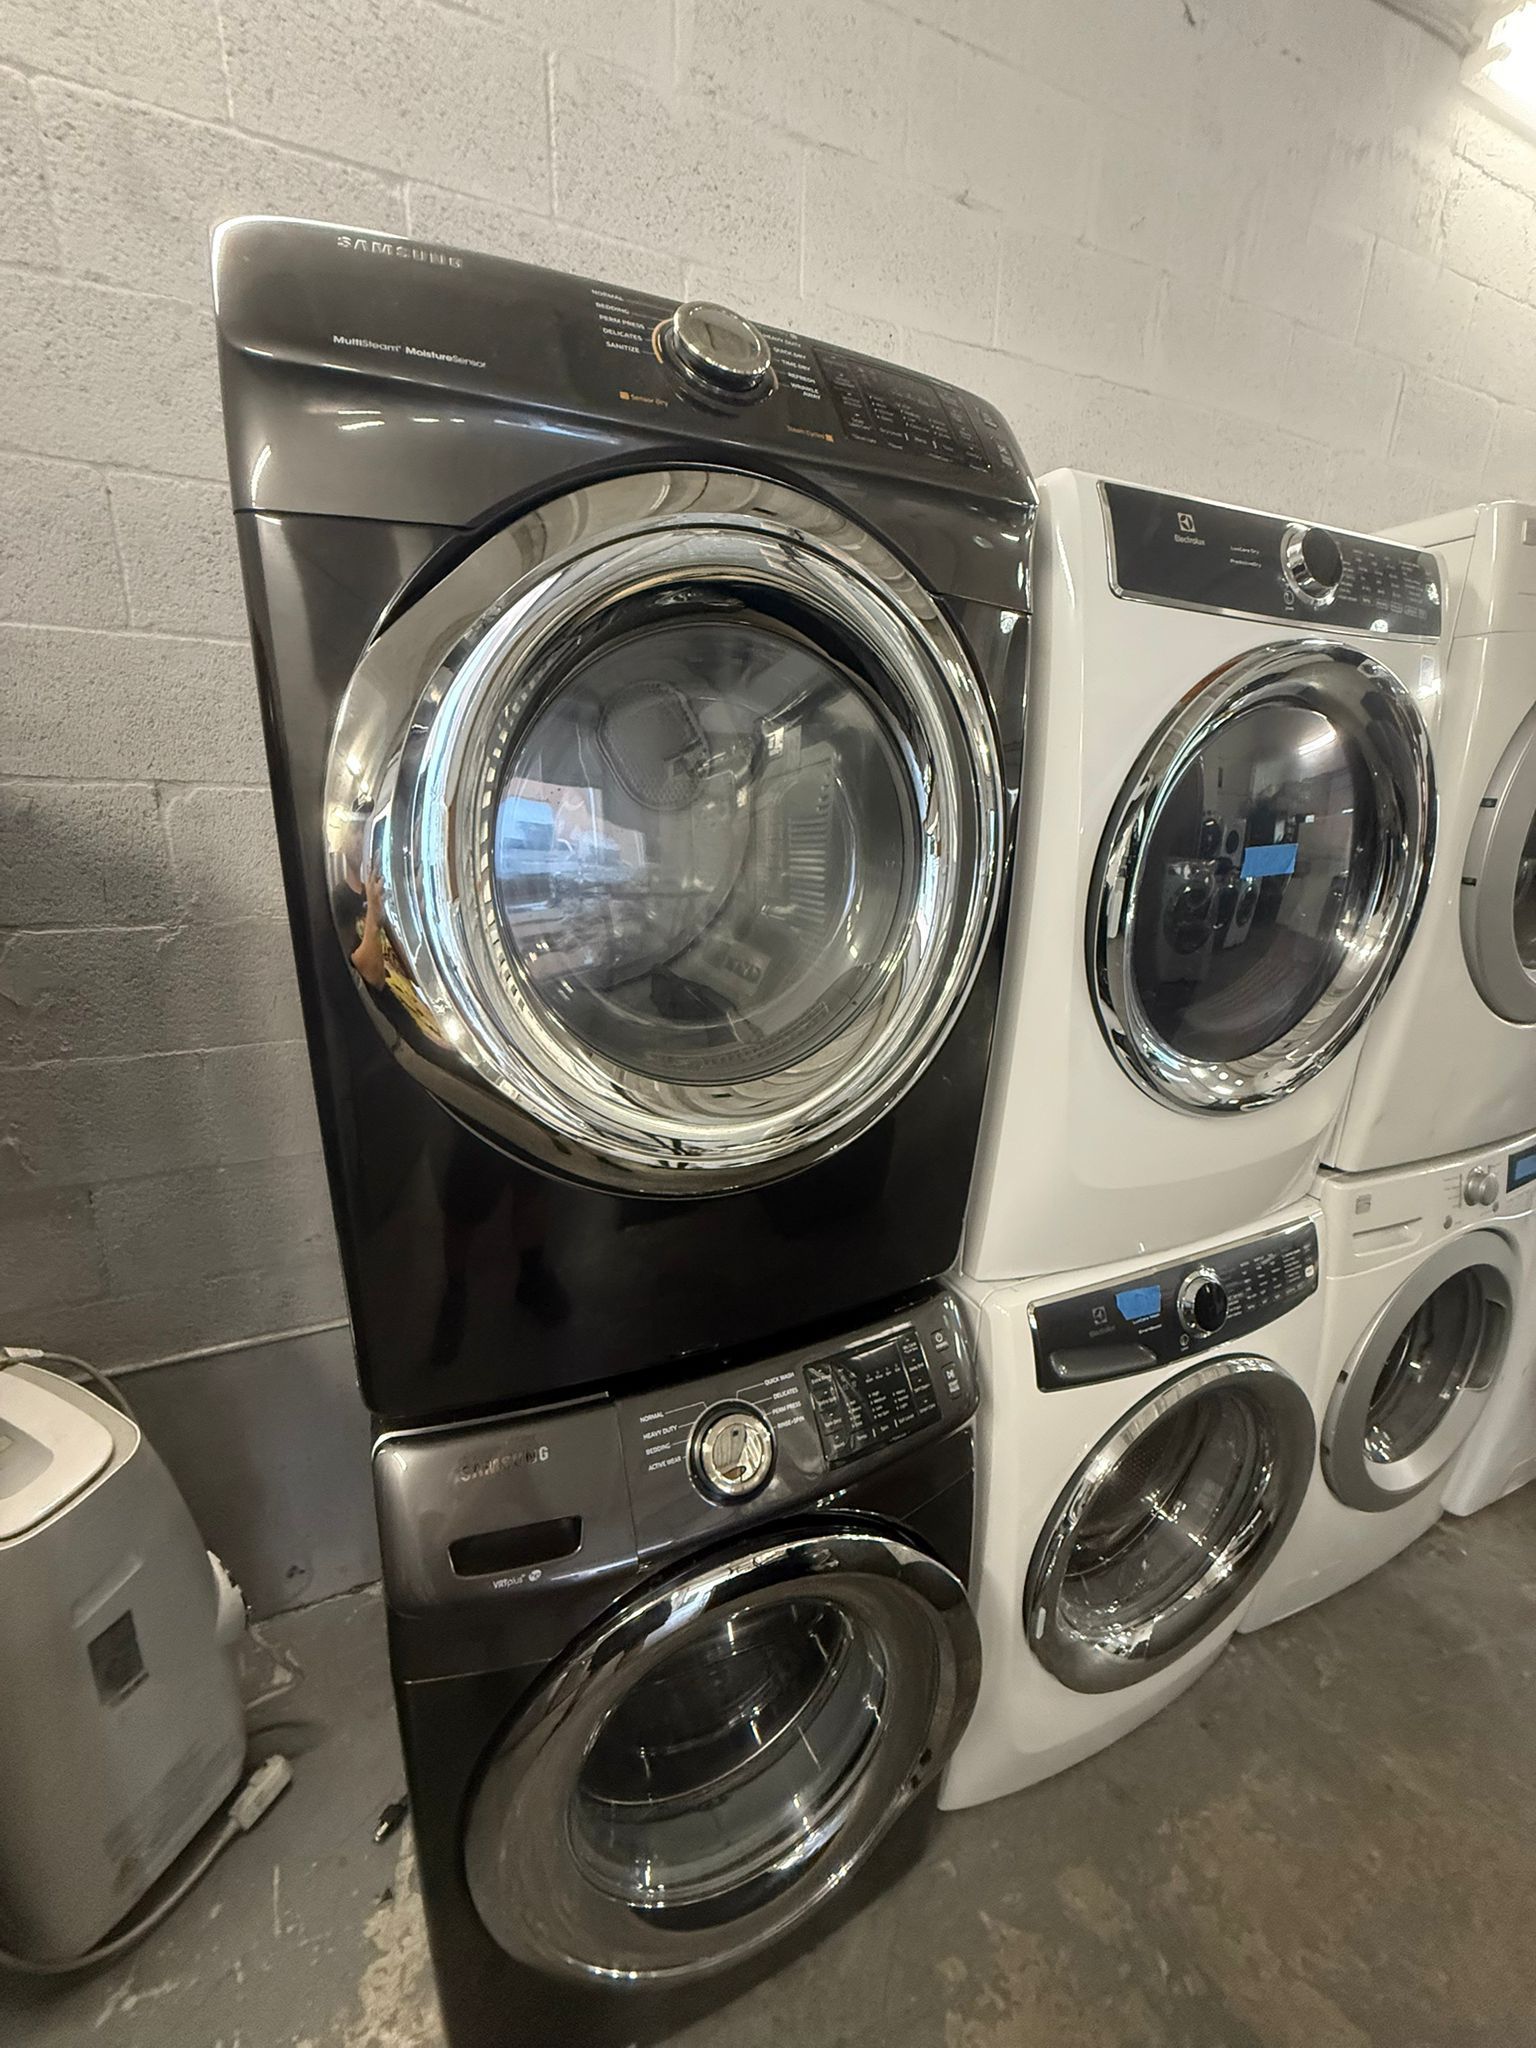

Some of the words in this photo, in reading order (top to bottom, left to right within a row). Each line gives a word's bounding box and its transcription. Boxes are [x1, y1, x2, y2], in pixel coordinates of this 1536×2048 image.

[337, 236, 463, 268] SAMSUNG
[595, 302, 630, 315] BEDDING
[599, 314, 621, 324] PERM
[622, 319, 645, 330] PRESS
[602, 327, 643, 341] DELICATES
[605, 341, 640, 353] SANITIZE
[405, 346, 487, 368] MoistureSensor
[1174, 534, 1206, 546] Electrolux
[763, 1375, 780, 1386] QUICK
[779, 1371, 795, 1382] WASH
[773, 1387, 799, 1400] DELICATES
[639, 1411, 665, 1423] NORMAL
[643, 1429, 663, 1440] HEAVY
[662, 1424, 678, 1435] DUTY
[645, 1442, 671, 1455] BEDDING
[457, 1446, 549, 1482] SAMSUNG
[648, 1460, 667, 1471] ACTIVE
[666, 1455, 682, 1466] WEAR
